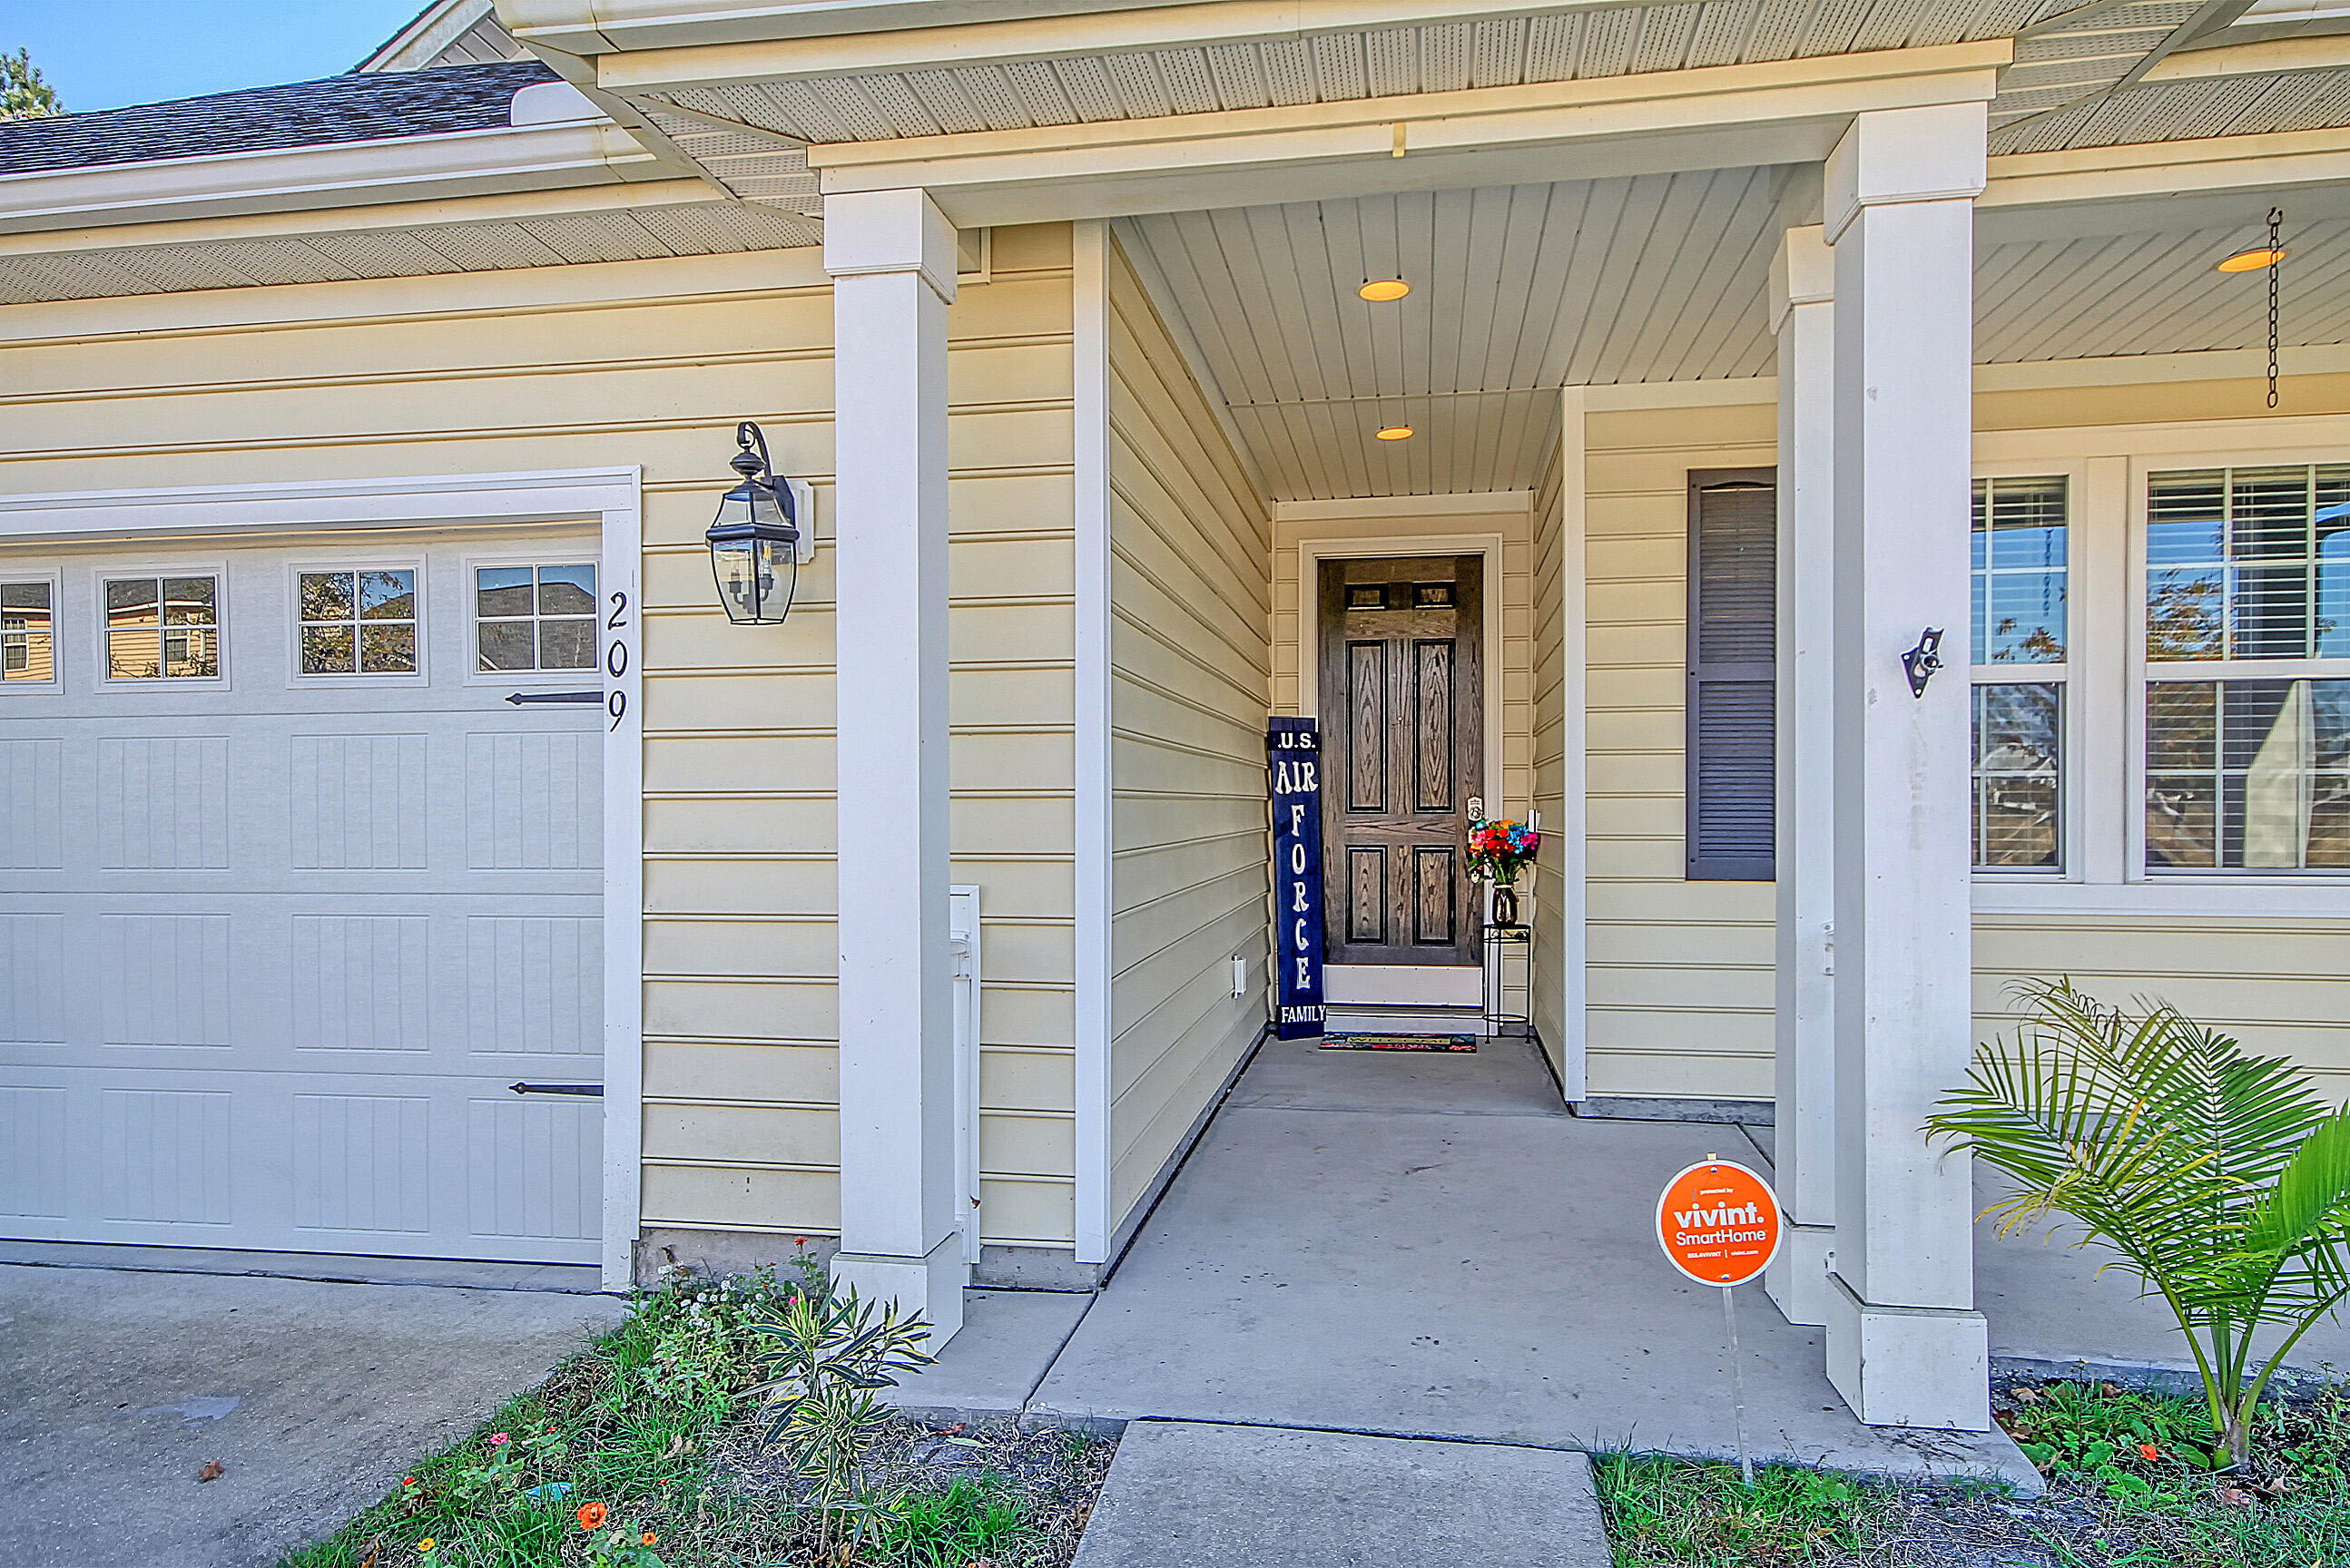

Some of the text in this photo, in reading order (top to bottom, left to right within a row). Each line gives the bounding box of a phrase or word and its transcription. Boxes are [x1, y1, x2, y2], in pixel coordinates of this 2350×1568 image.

[607, 591, 628, 733] 209
[1274, 760, 1319, 795] AIR
[1290, 804, 1311, 990] FORCE
[1281, 1004, 1327, 1024] FAMILY
[1676, 1230, 1766, 1247] SmartHome
